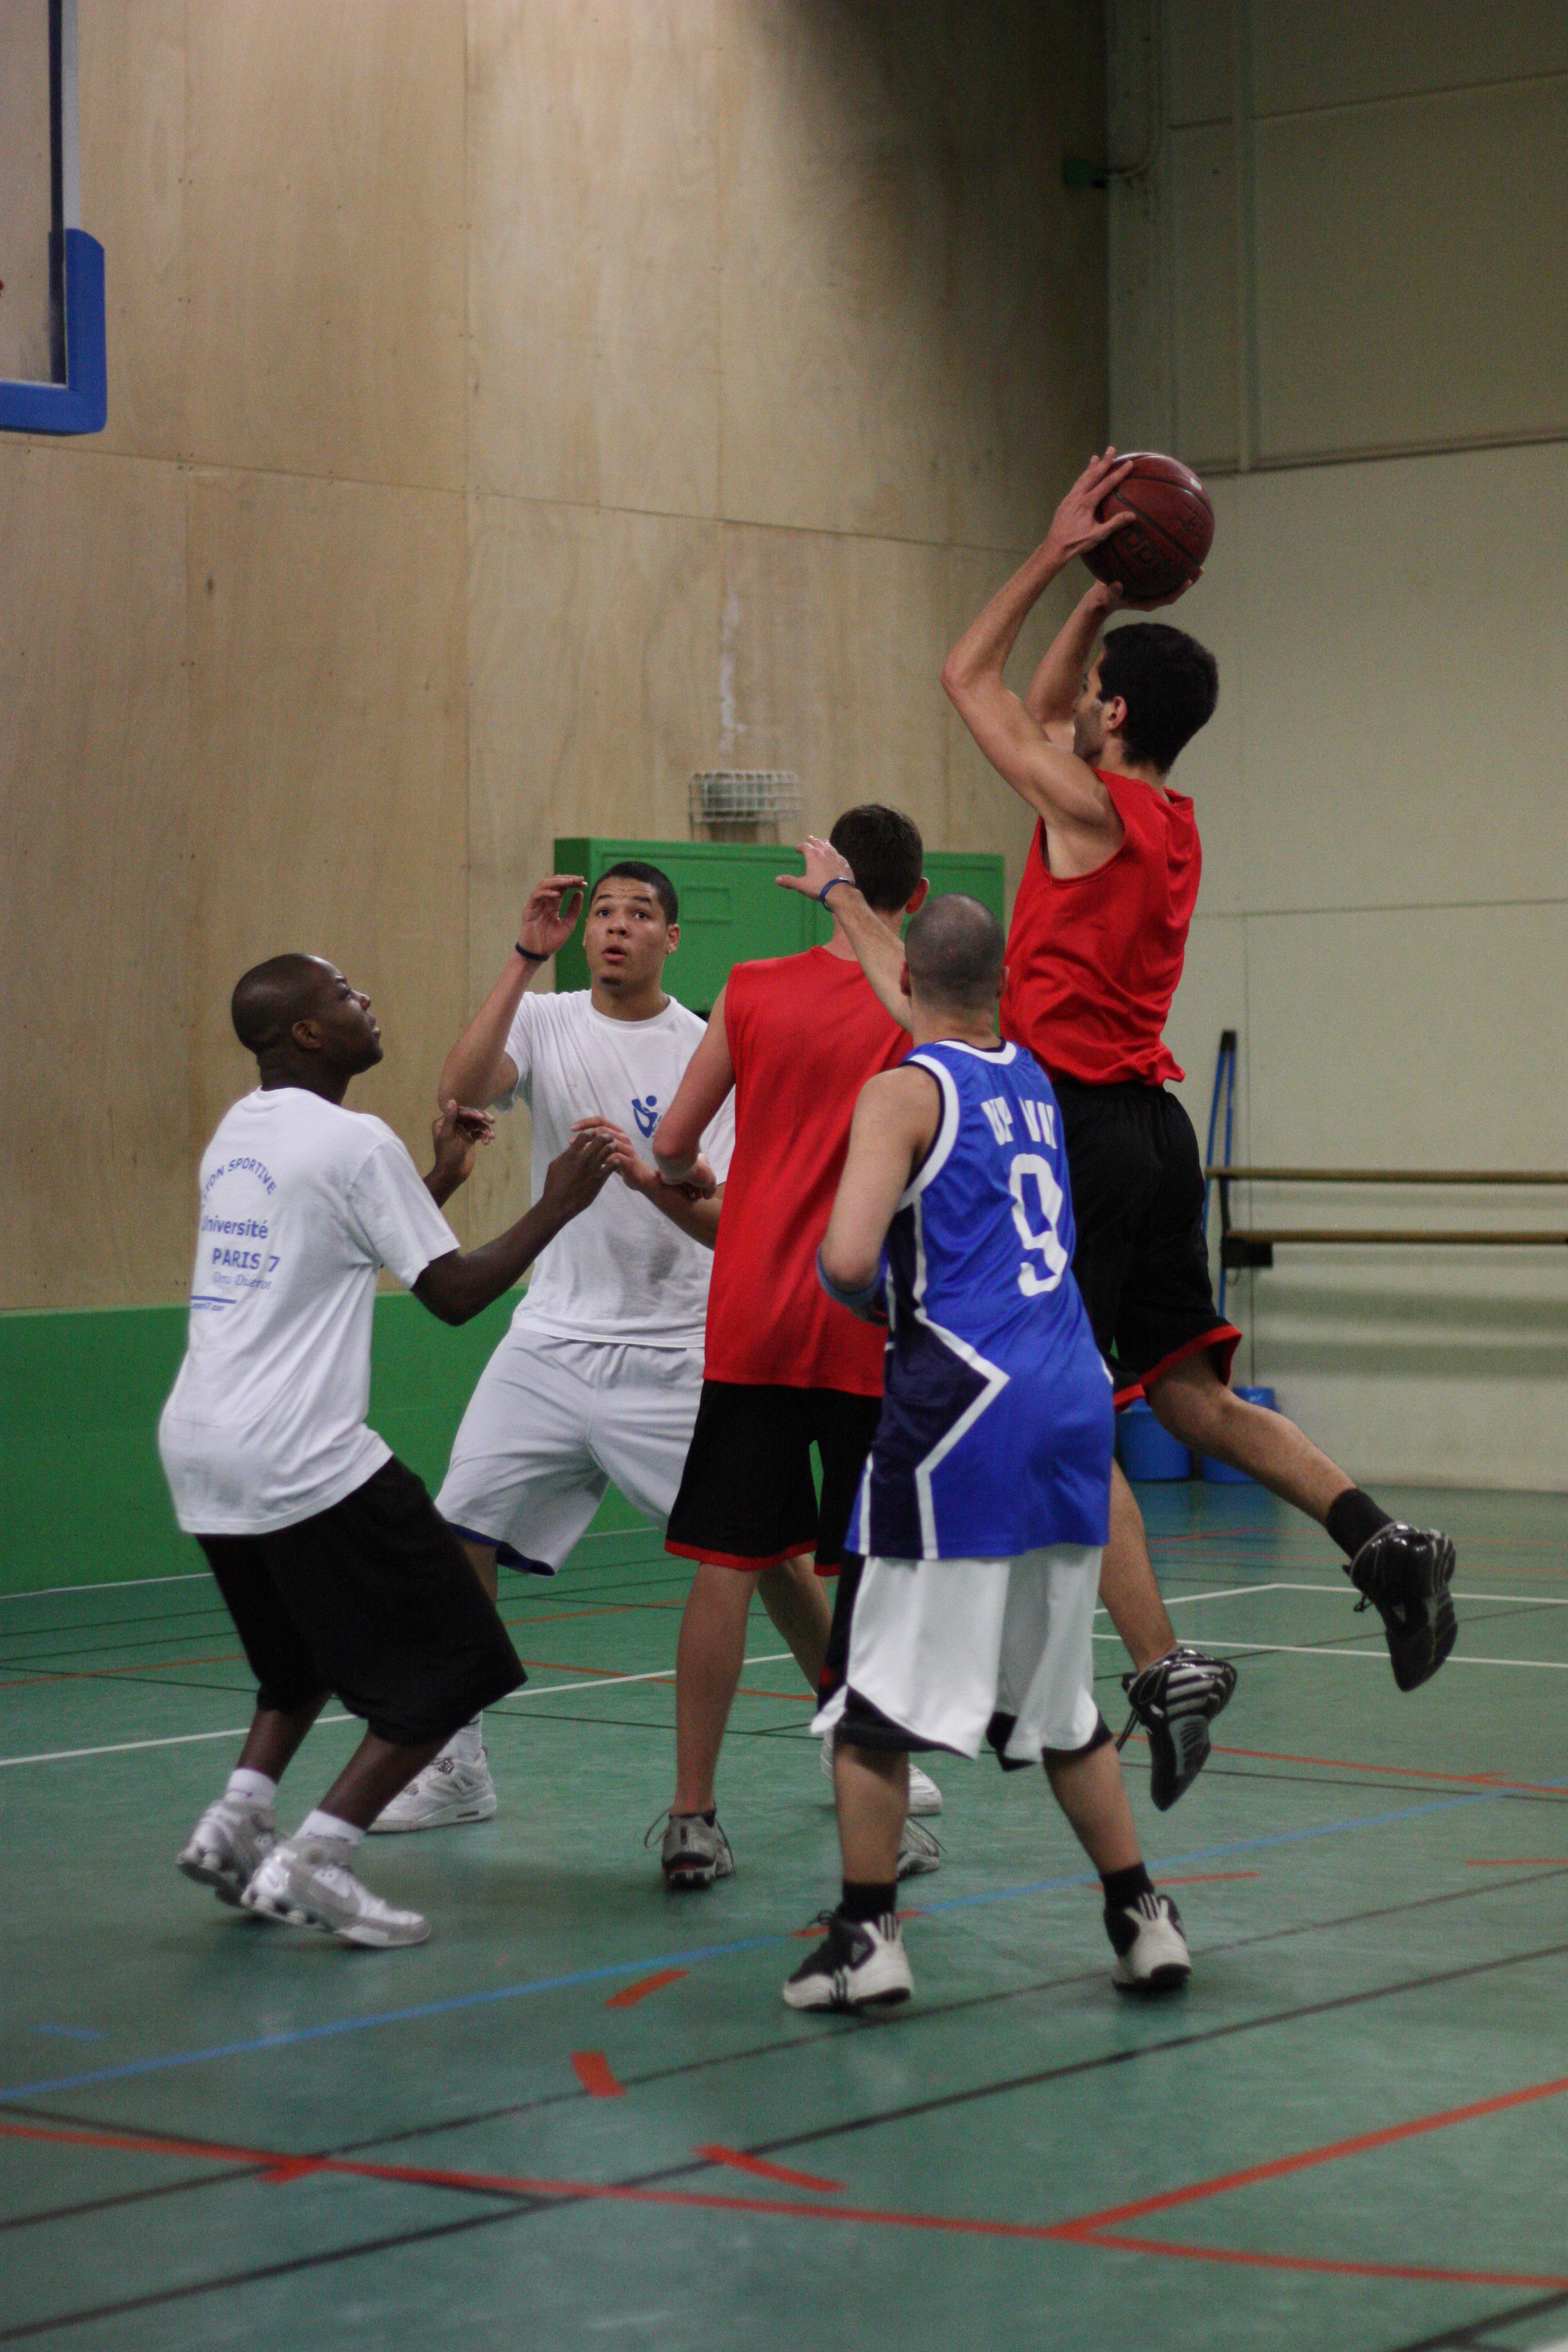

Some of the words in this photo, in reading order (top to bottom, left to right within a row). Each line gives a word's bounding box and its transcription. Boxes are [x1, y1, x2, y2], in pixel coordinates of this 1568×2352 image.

[228, 1157, 276, 1194] SPORTIVE
[1009, 1153, 1068, 1297] 9
[213, 1248, 261, 1270] PARIS
[269, 1255, 280, 1272] 7
